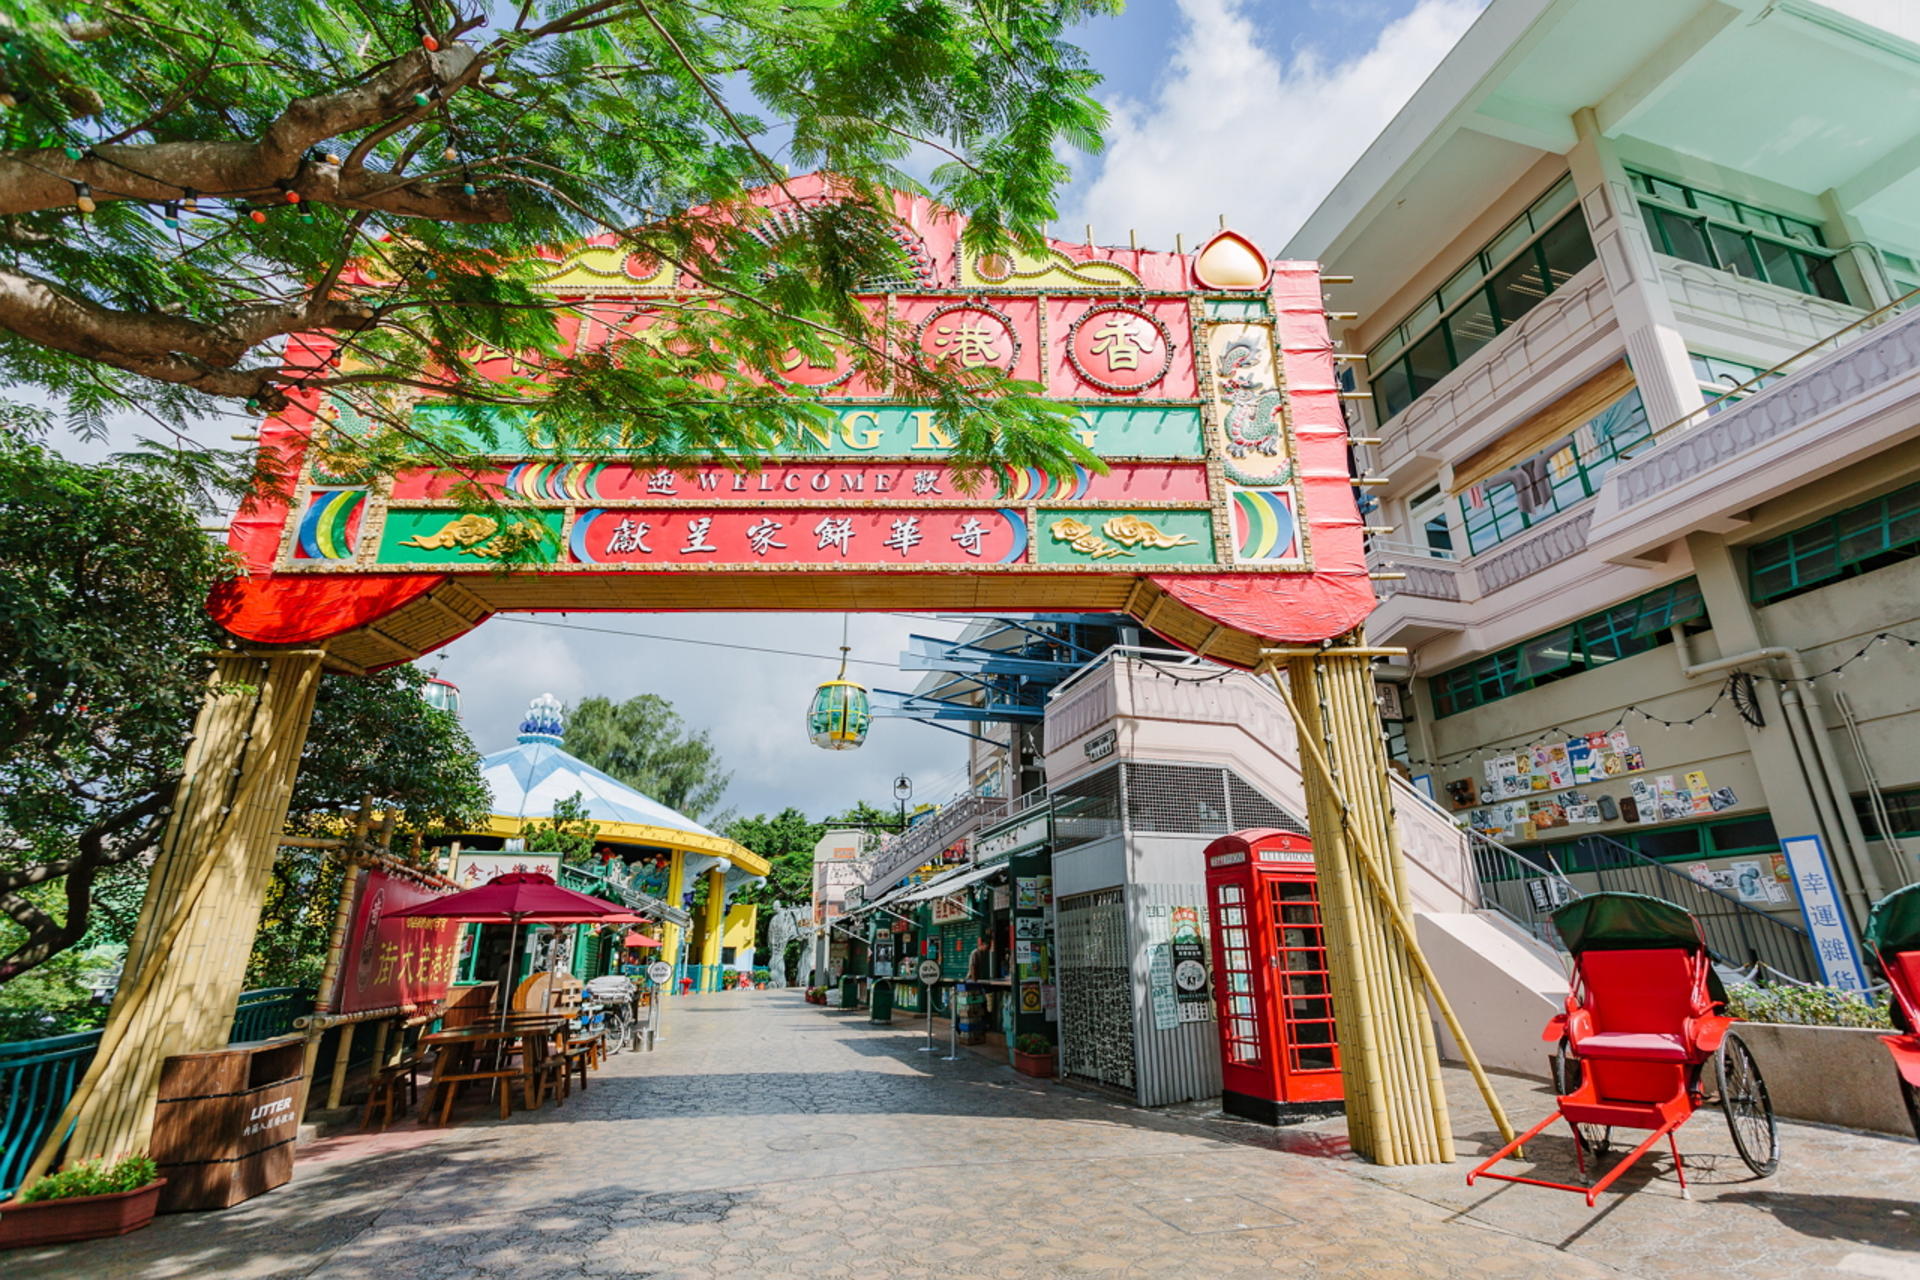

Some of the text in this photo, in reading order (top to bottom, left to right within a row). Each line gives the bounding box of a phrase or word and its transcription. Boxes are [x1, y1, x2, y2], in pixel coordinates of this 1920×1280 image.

[647, 469, 677, 495] 迎
[698, 472, 891, 491] WELCOME
[250, 1096, 292, 1121] LITTER
